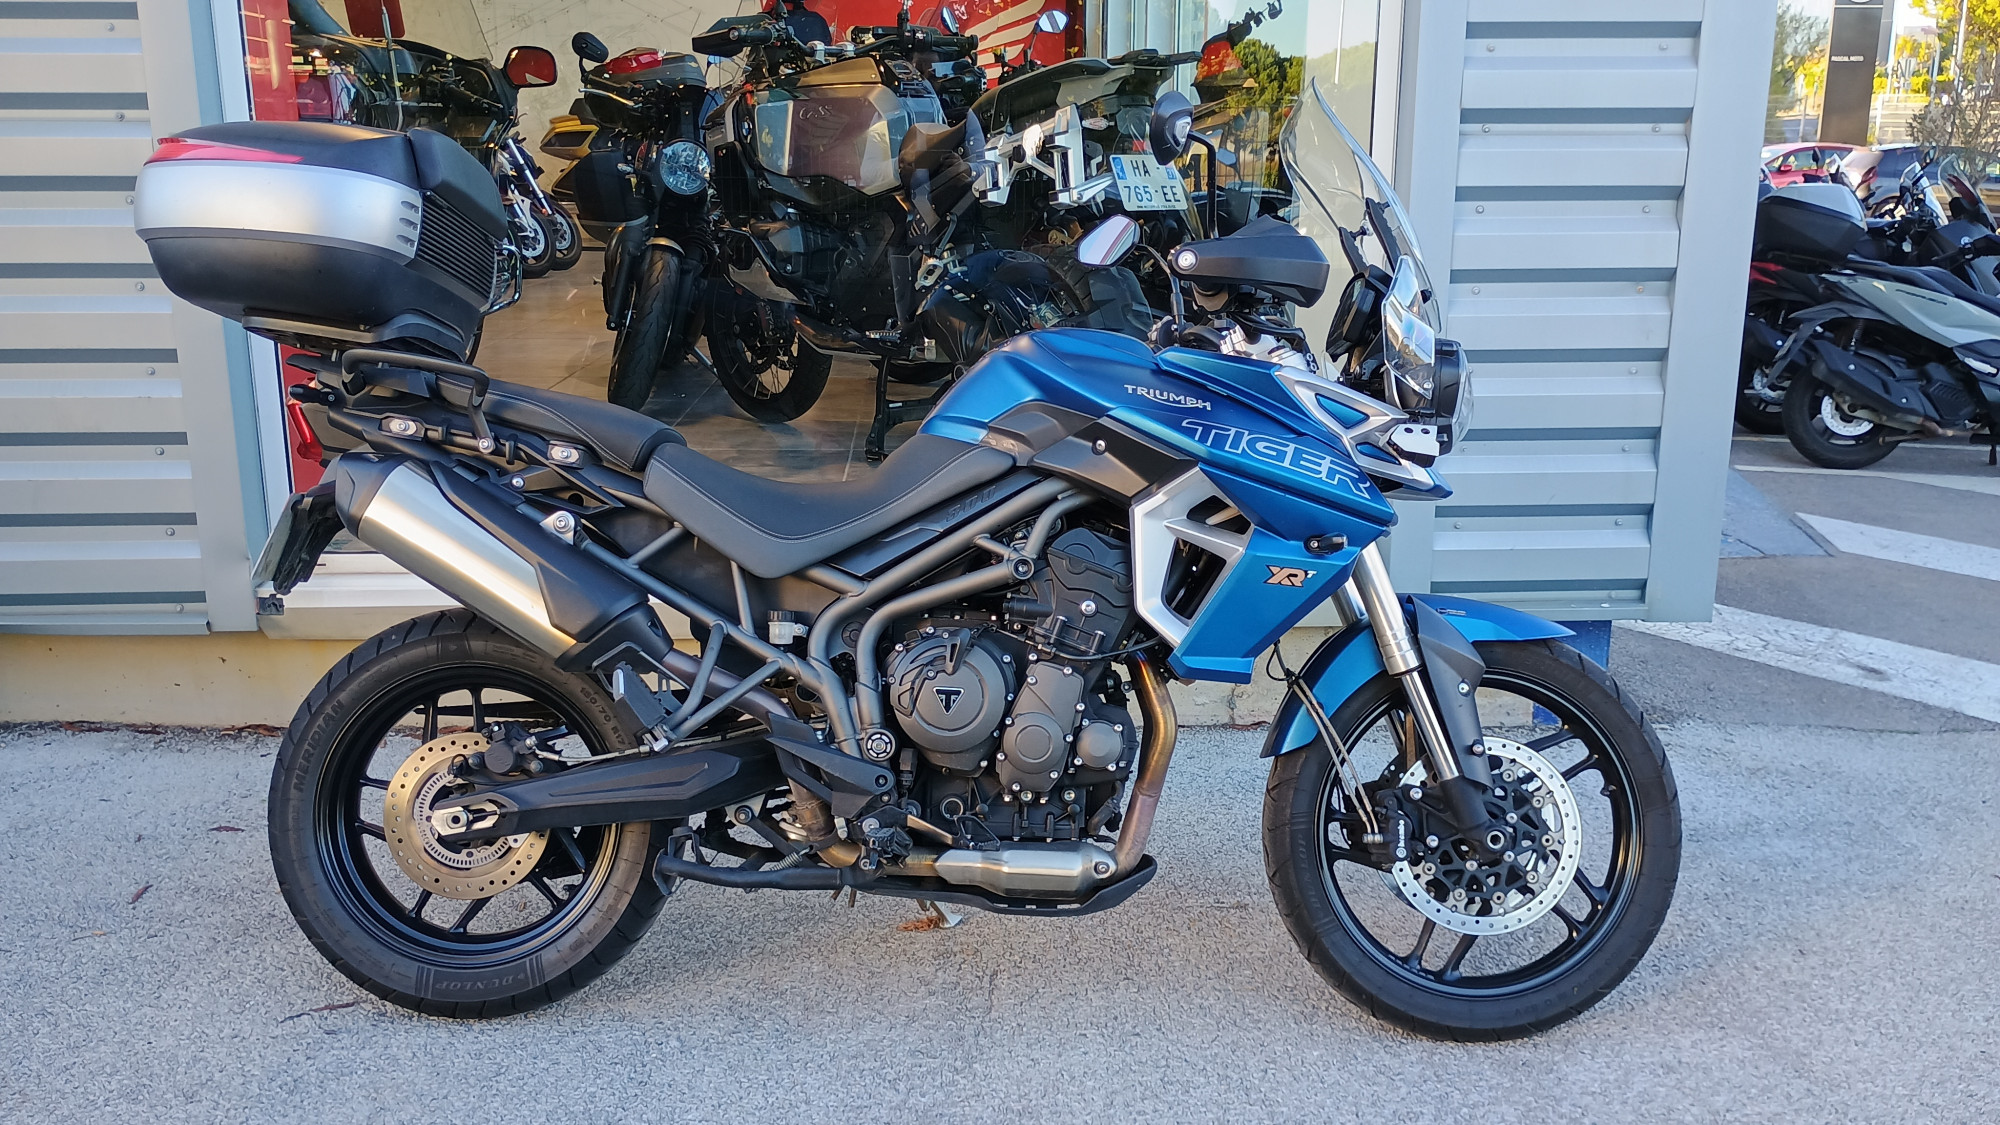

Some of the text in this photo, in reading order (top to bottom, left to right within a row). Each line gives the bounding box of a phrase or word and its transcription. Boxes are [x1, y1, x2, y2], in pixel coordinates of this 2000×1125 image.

[1123, 384, 1212, 411] TRIUMPH
[1181, 418, 1372, 500] TIGER
[293, 698, 345, 794] MERIDIAN
[1298, 833, 1322, 909] DUNLOP
[435, 975, 515, 990] DUNLOP
